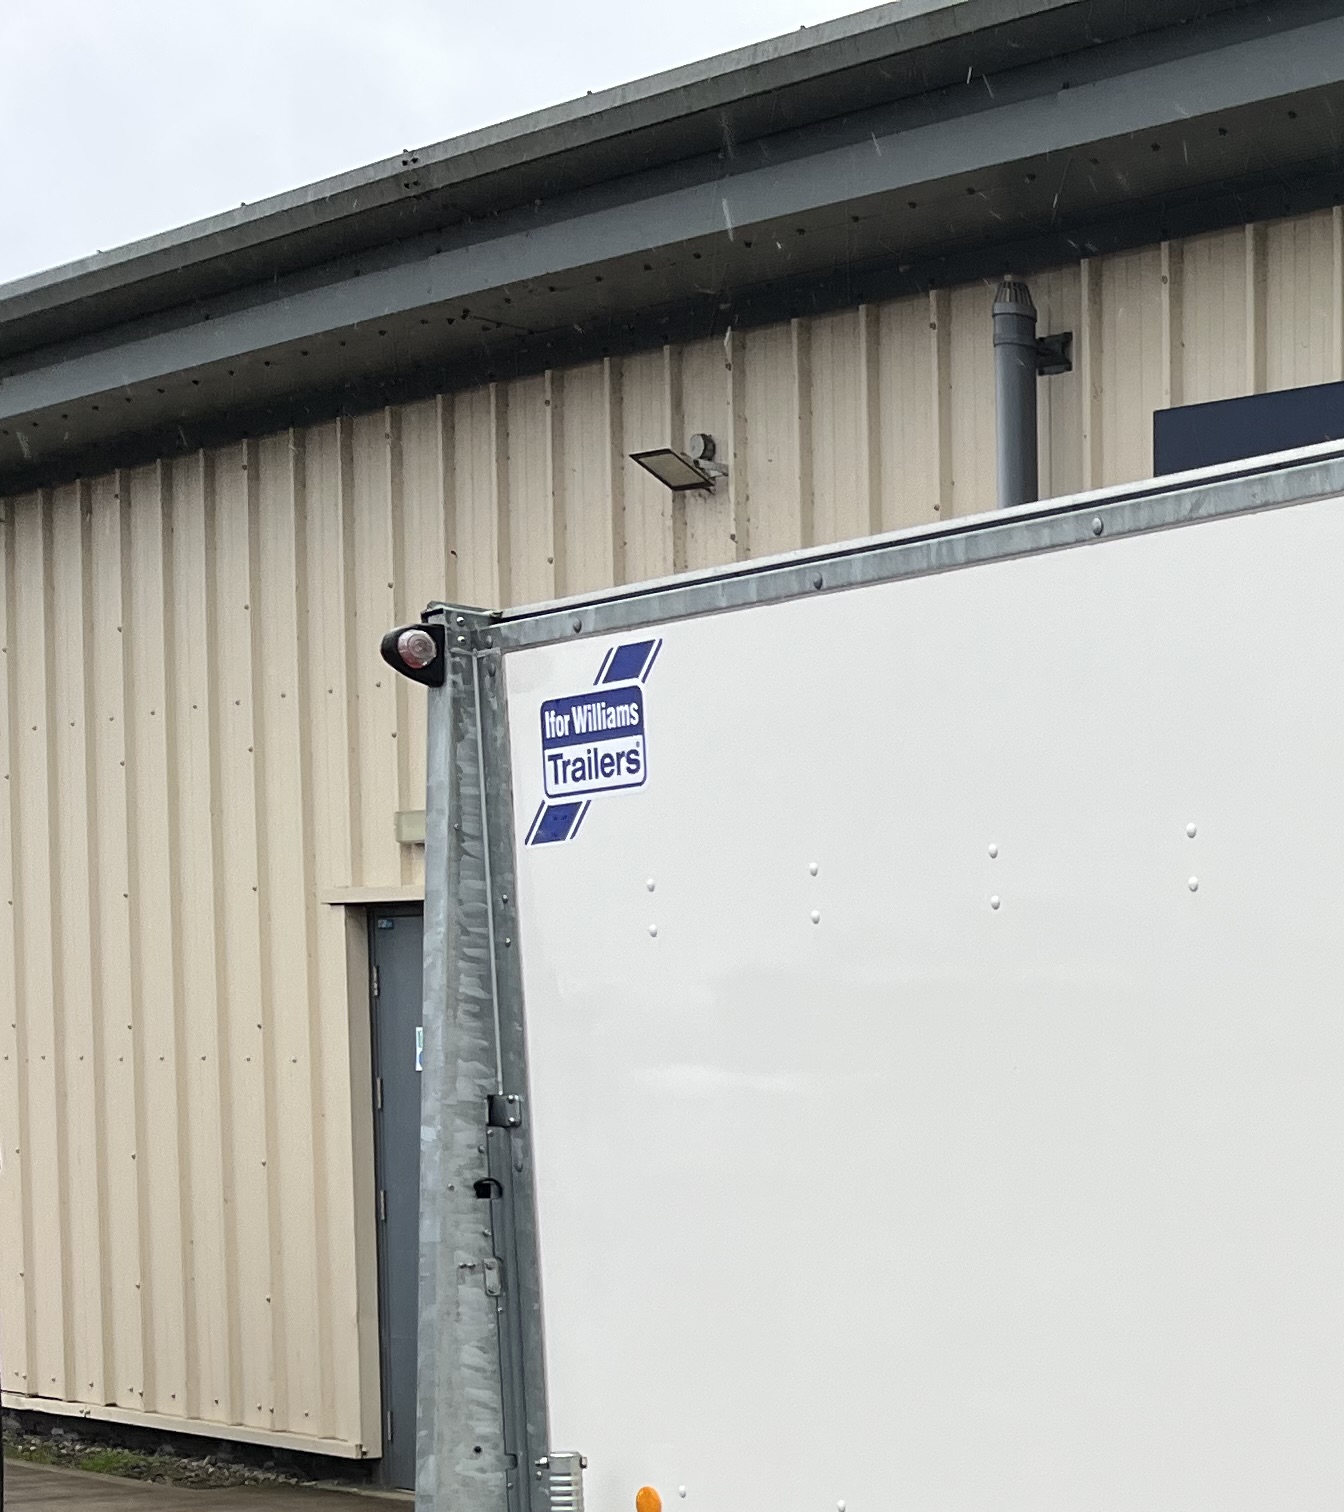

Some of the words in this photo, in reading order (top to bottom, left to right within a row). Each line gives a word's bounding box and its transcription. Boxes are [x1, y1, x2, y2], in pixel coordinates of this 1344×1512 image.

[544, 710, 571, 738] Ifor
[571, 702, 639, 734] Williams
[548, 748, 641, 784] Trailers
